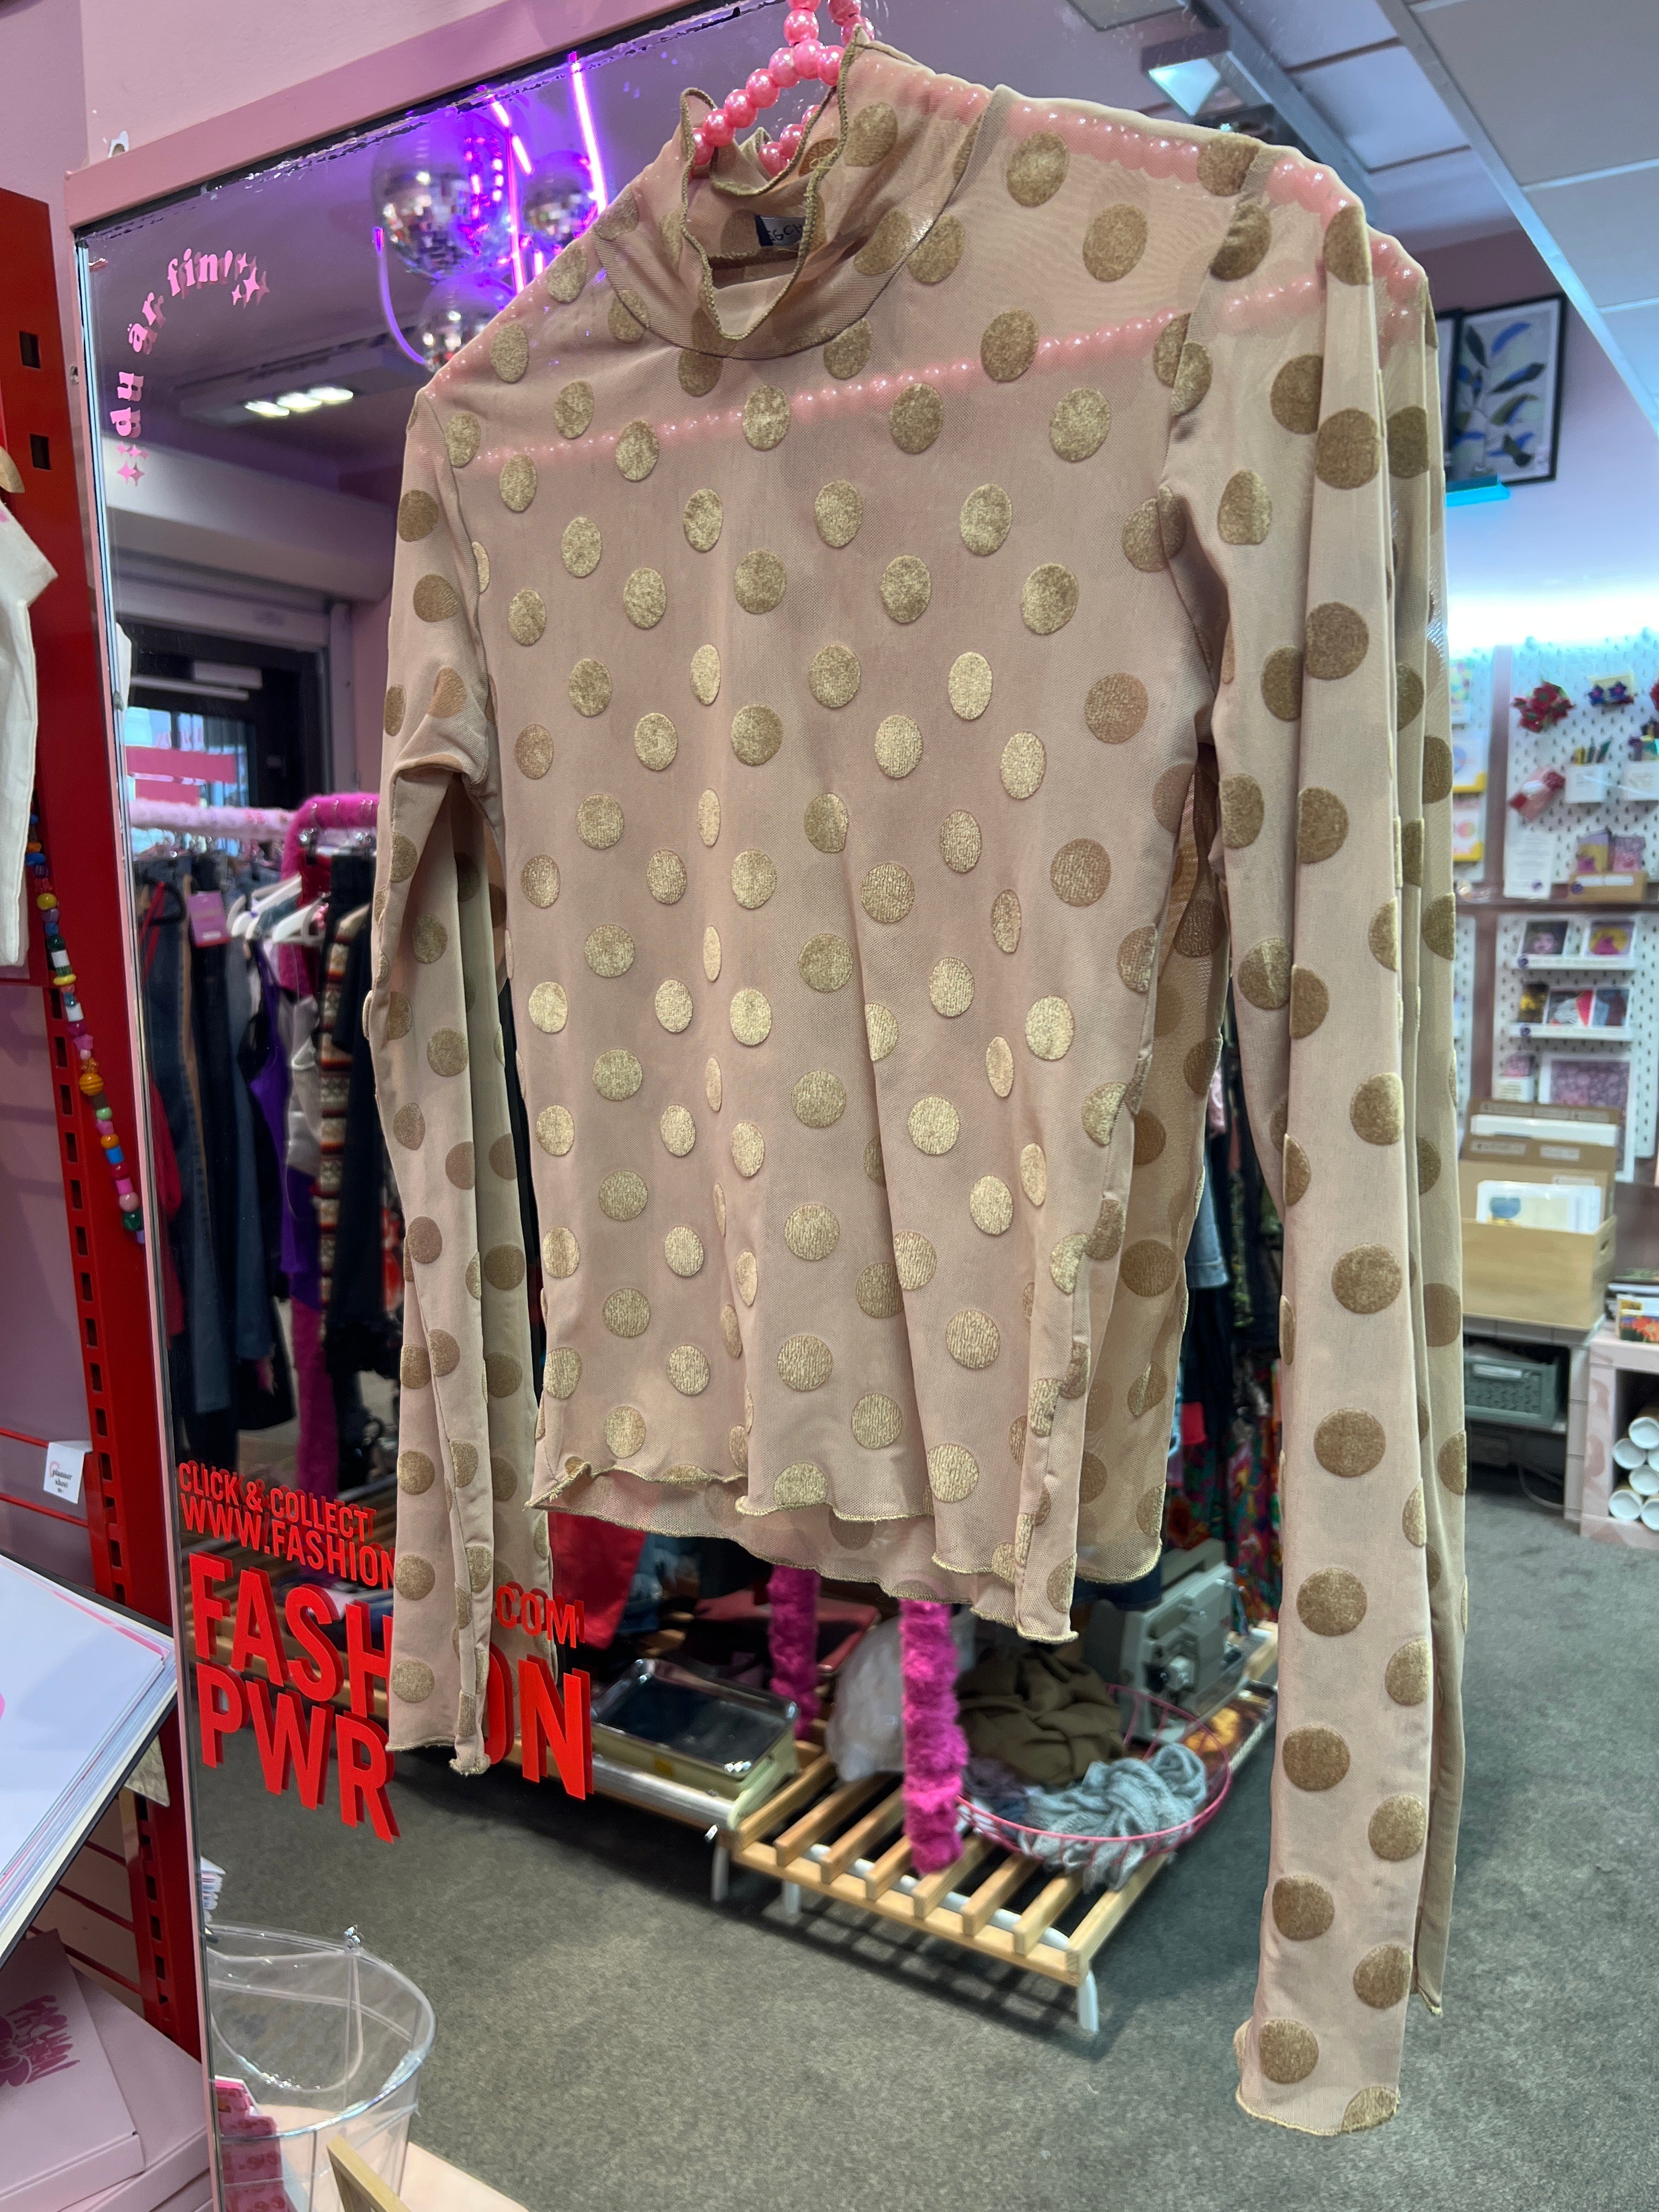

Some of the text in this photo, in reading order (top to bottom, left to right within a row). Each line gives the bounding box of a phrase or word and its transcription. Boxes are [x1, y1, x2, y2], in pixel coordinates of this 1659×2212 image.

[110, 371, 134, 437] du
[179, 1463, 368, 1542] CLICK & COLLECT
[189, 1552, 586, 1801] FASHN
[196, 1662, 394, 1844] PWR
